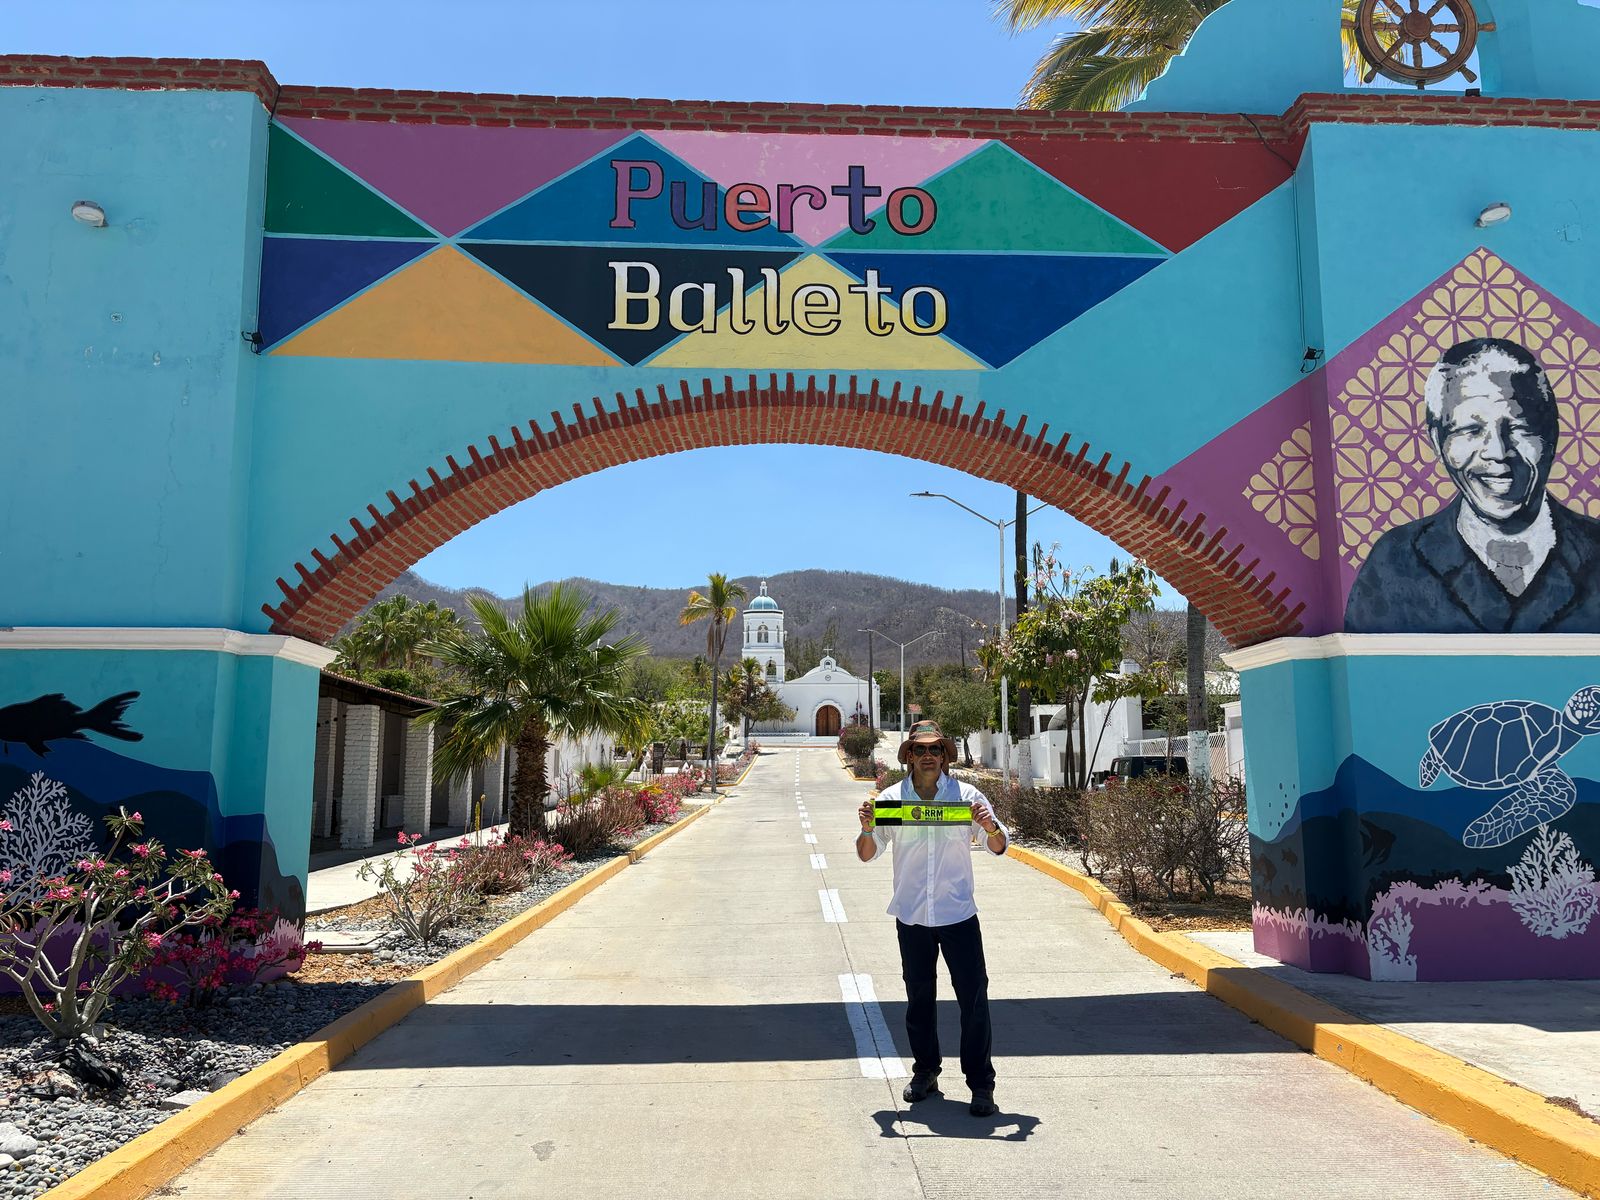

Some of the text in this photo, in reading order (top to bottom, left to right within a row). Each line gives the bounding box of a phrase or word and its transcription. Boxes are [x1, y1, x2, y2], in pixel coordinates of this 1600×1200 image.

[609, 159, 937, 236] Puerto
[607, 261, 947, 336] Balleto
[925, 809, 943, 817] RRM
